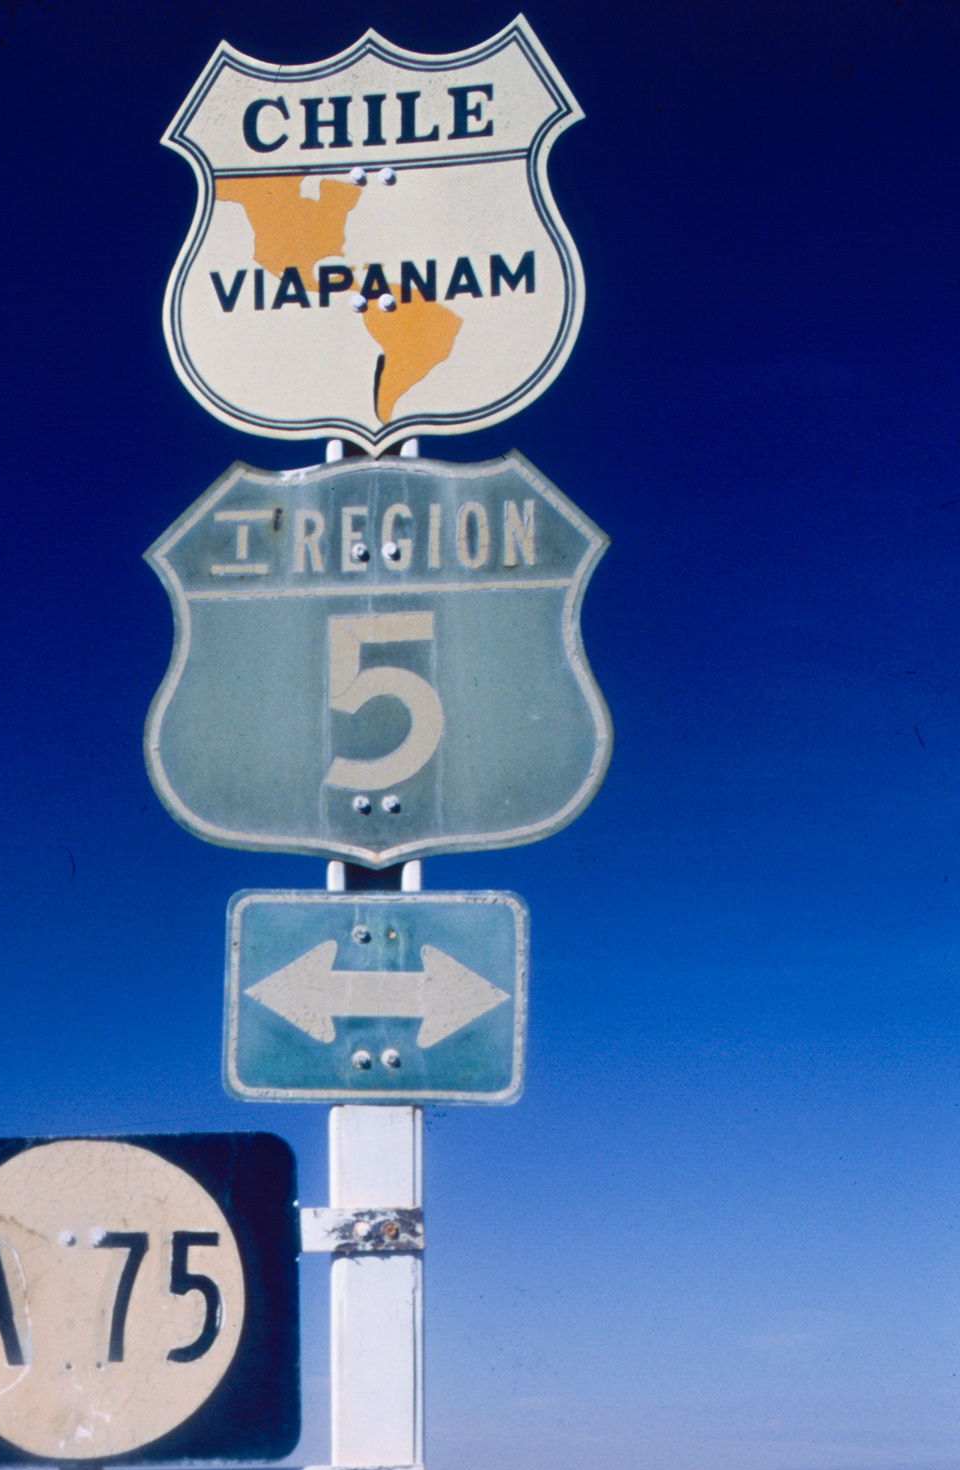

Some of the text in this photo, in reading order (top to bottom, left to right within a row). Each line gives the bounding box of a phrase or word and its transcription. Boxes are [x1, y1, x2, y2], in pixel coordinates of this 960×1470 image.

[242, 83, 494, 154] CHILE
[209, 250, 536, 313] VIAPANAM
[293, 499, 536, 574] REGION
[325, 610, 444, 791] 5
[92, 1230, 223, 1363] 75
